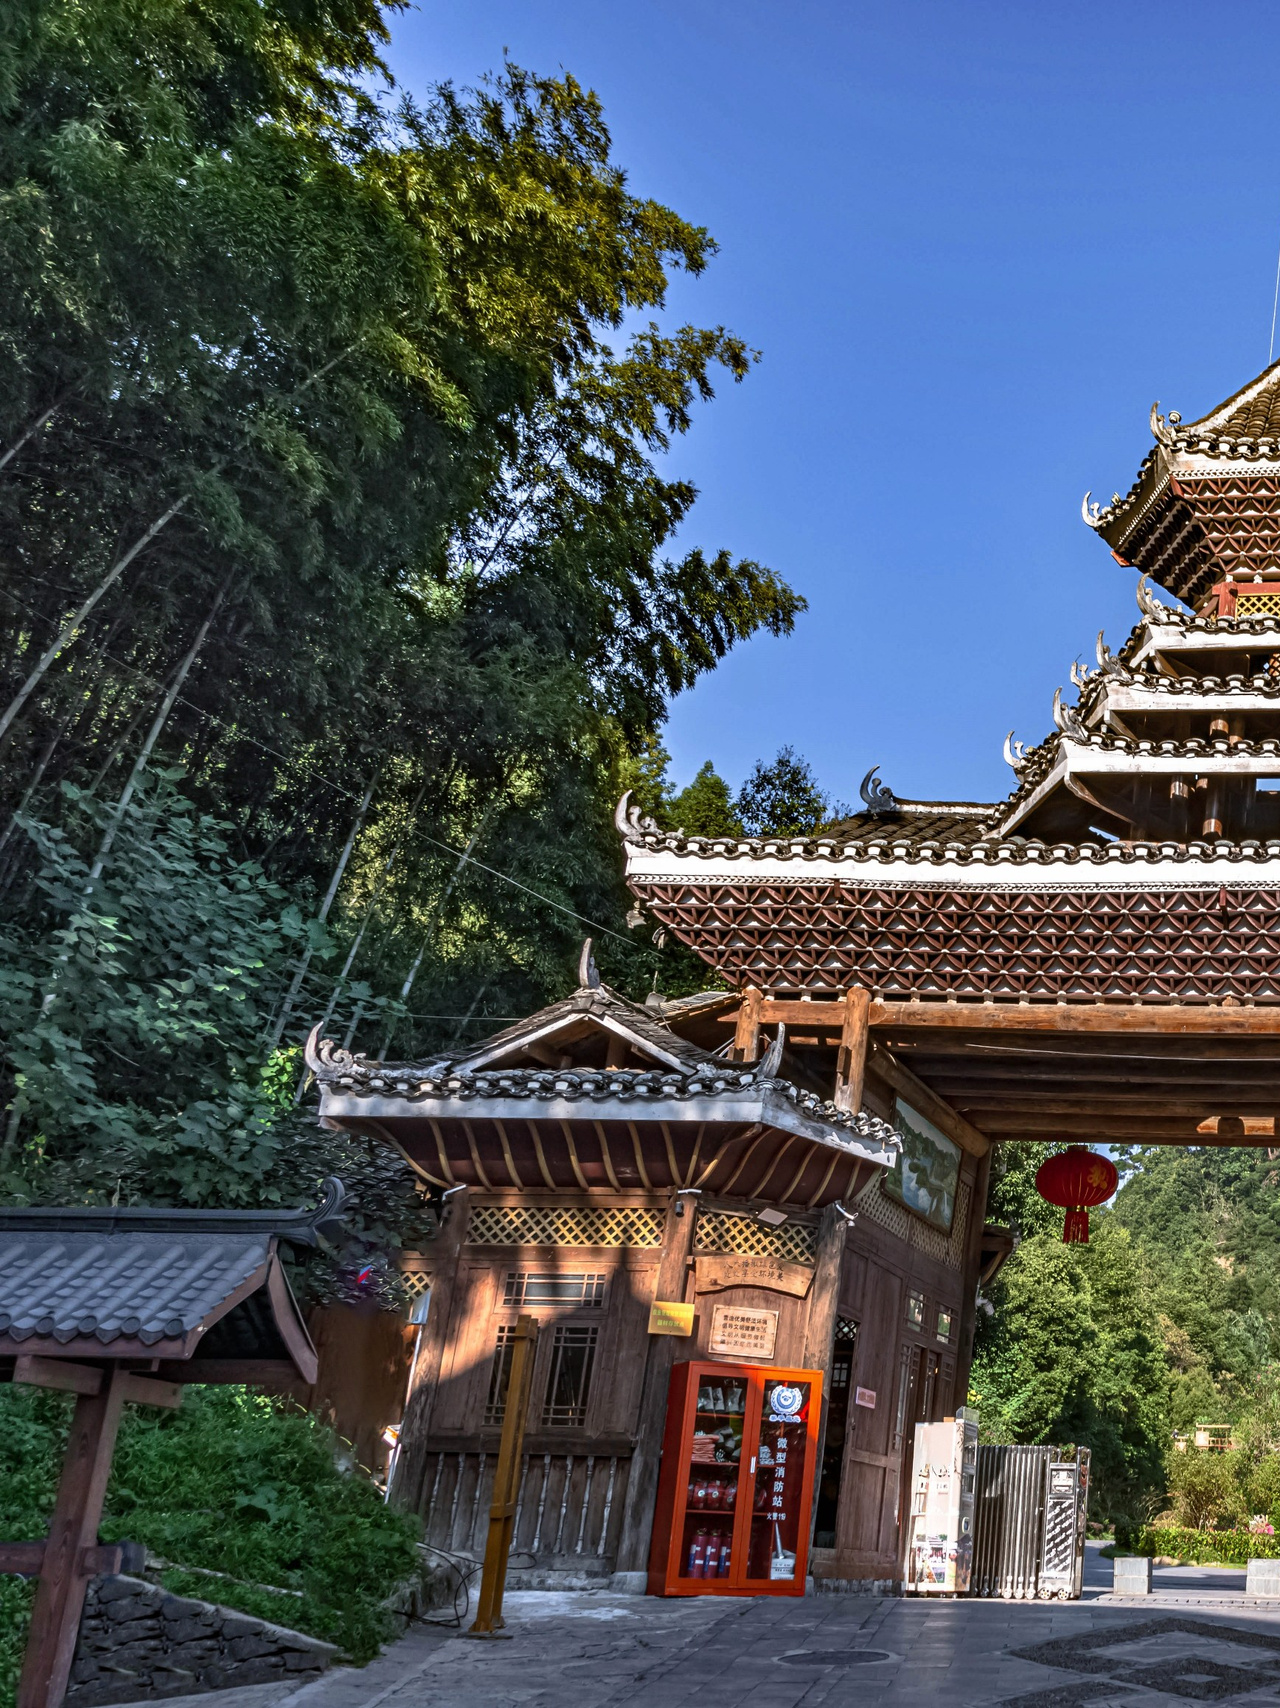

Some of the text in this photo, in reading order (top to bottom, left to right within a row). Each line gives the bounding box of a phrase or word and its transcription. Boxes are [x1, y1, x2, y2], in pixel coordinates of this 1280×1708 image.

[772, 1437, 788, 1507] 微型消防站
